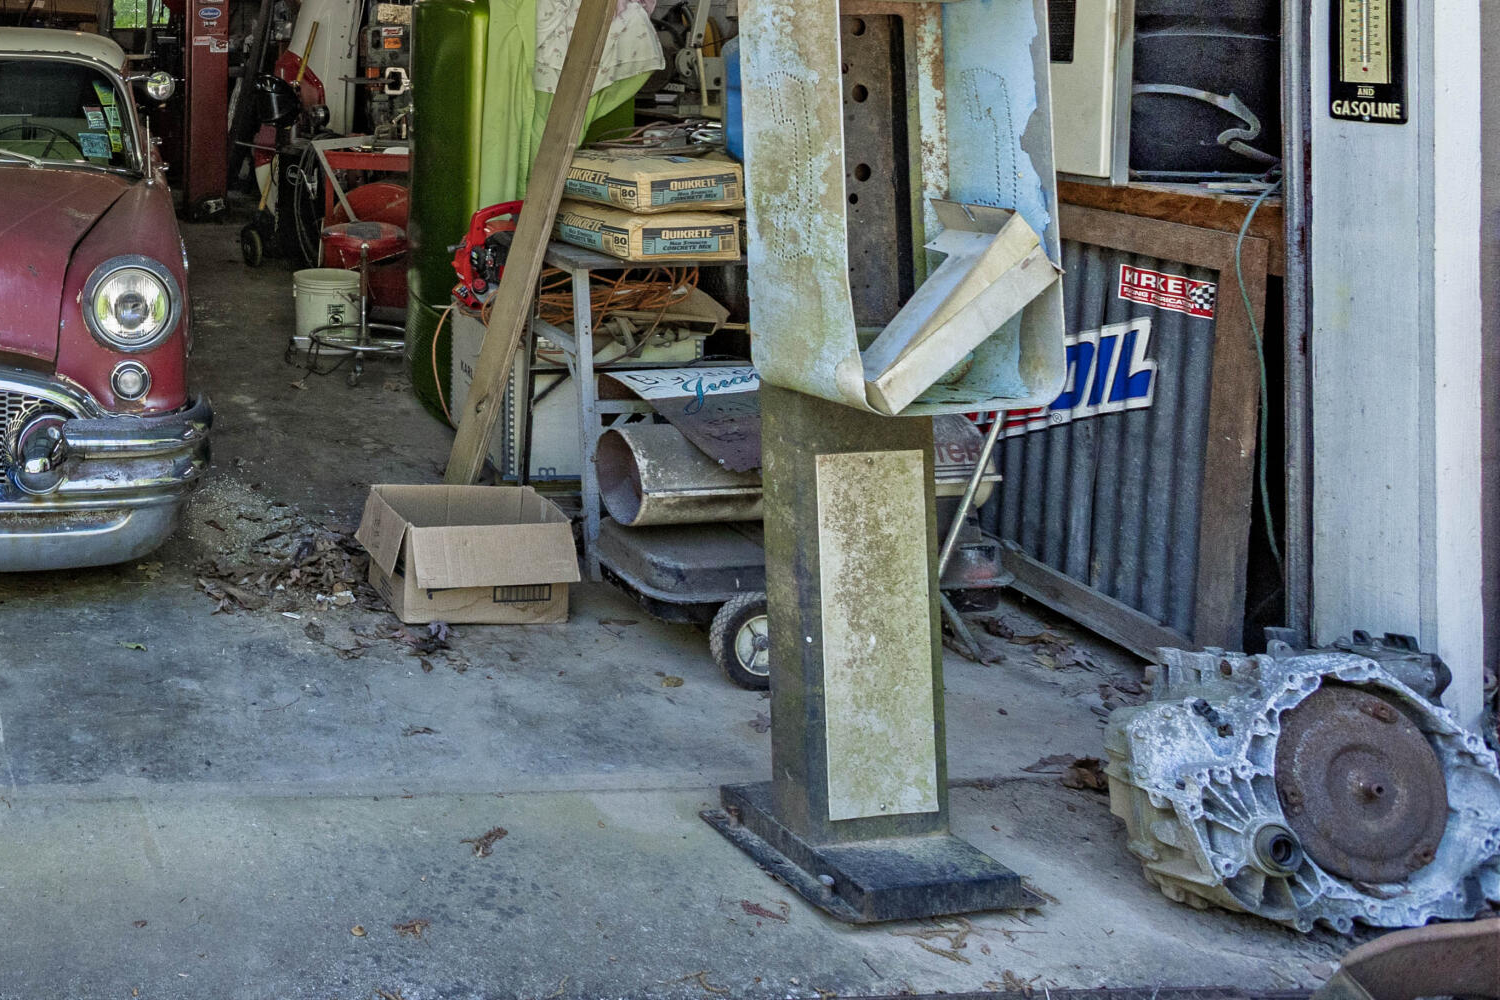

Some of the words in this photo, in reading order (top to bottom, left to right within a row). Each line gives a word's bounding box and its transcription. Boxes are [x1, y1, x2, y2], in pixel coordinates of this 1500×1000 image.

[1357, 88, 1375, 96] AND
[1332, 99, 1400, 118] GASOLINE
[669, 178, 717, 191] QUIKRETE
[621, 188, 636, 198] 80
[661, 229, 713, 240] QUIKRETE
[614, 236, 627, 246] 80
[1124, 269, 1192, 297] KIRKEY
